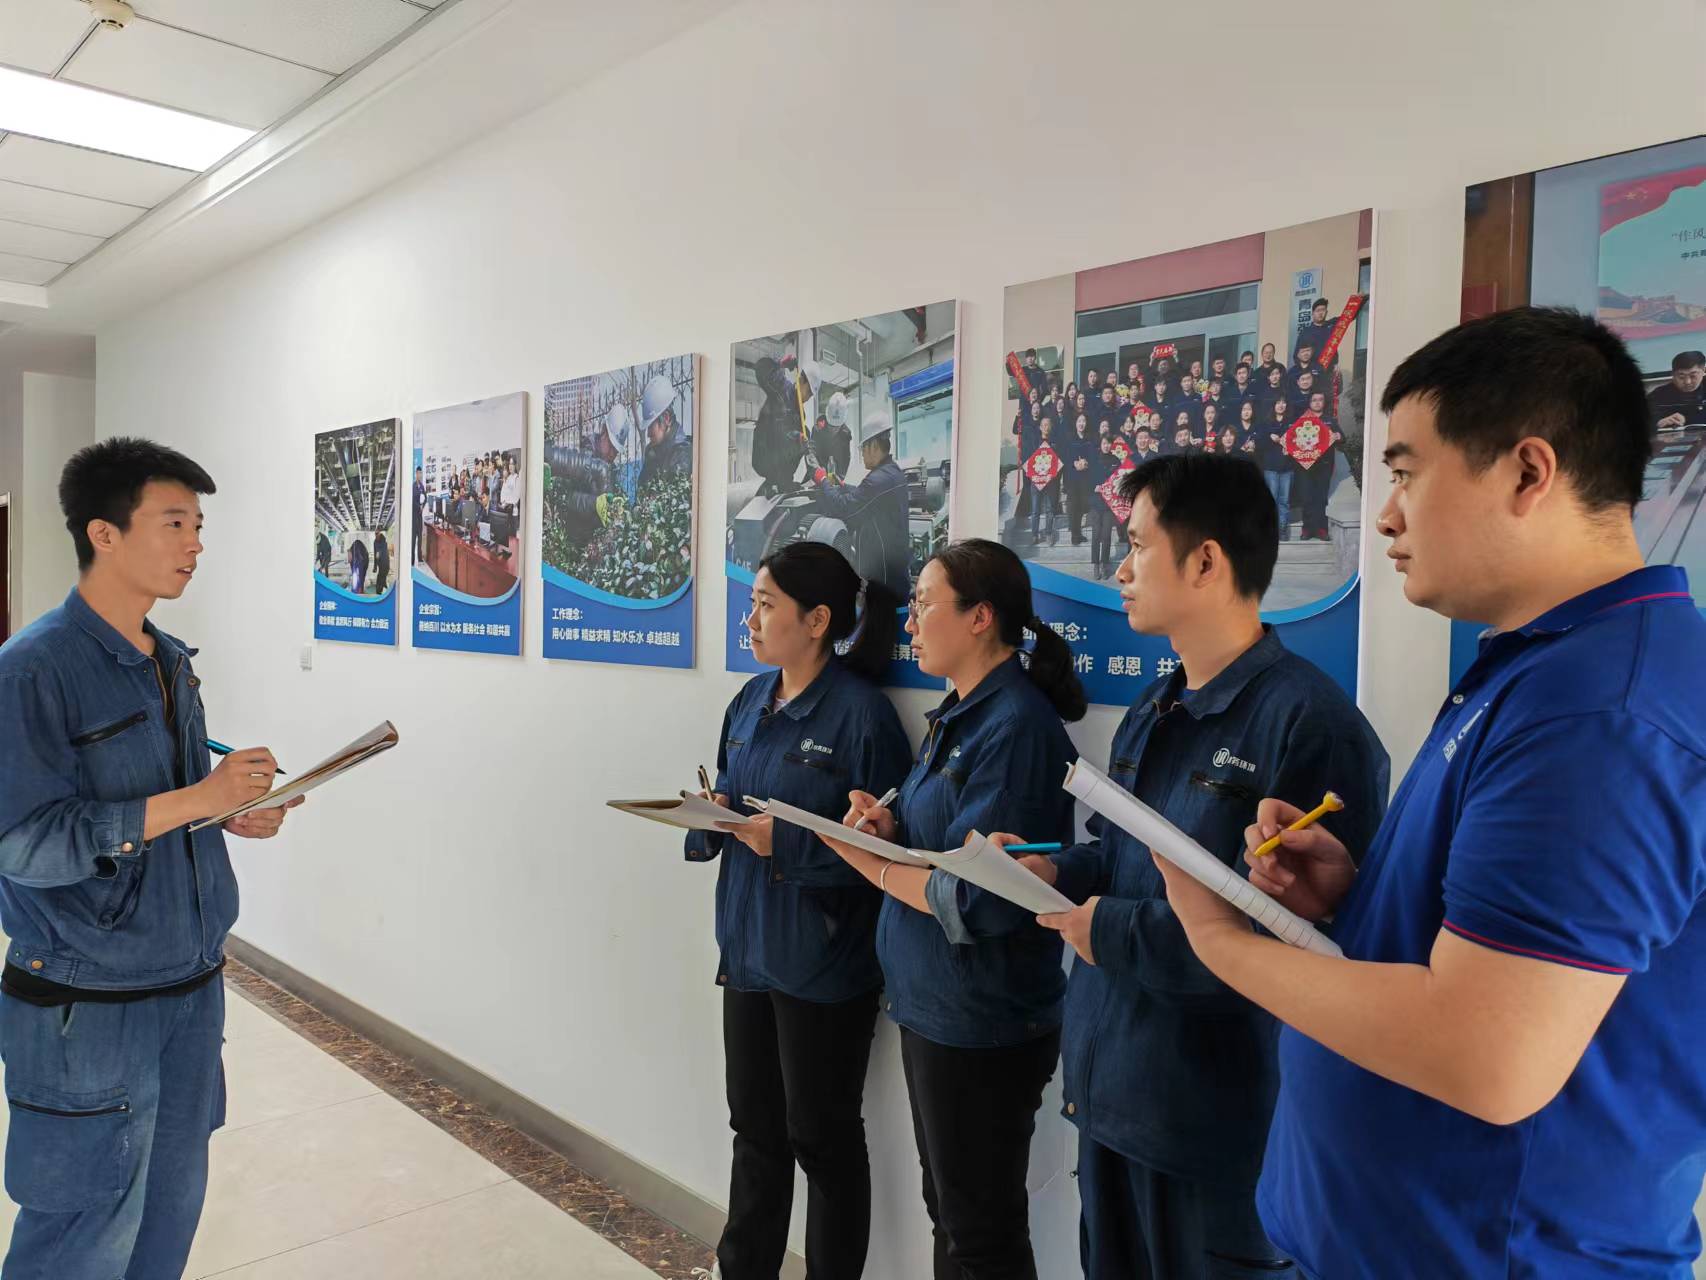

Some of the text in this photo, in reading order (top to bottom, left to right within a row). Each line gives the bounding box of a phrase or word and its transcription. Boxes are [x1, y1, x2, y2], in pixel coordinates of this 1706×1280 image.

[551, 607, 583, 621] 工作理念：
[551, 627, 680, 646] 用心做事 精益求精 知水乐水 卓越超越
[1073, 653, 1182, 678] 作 感恩 共
